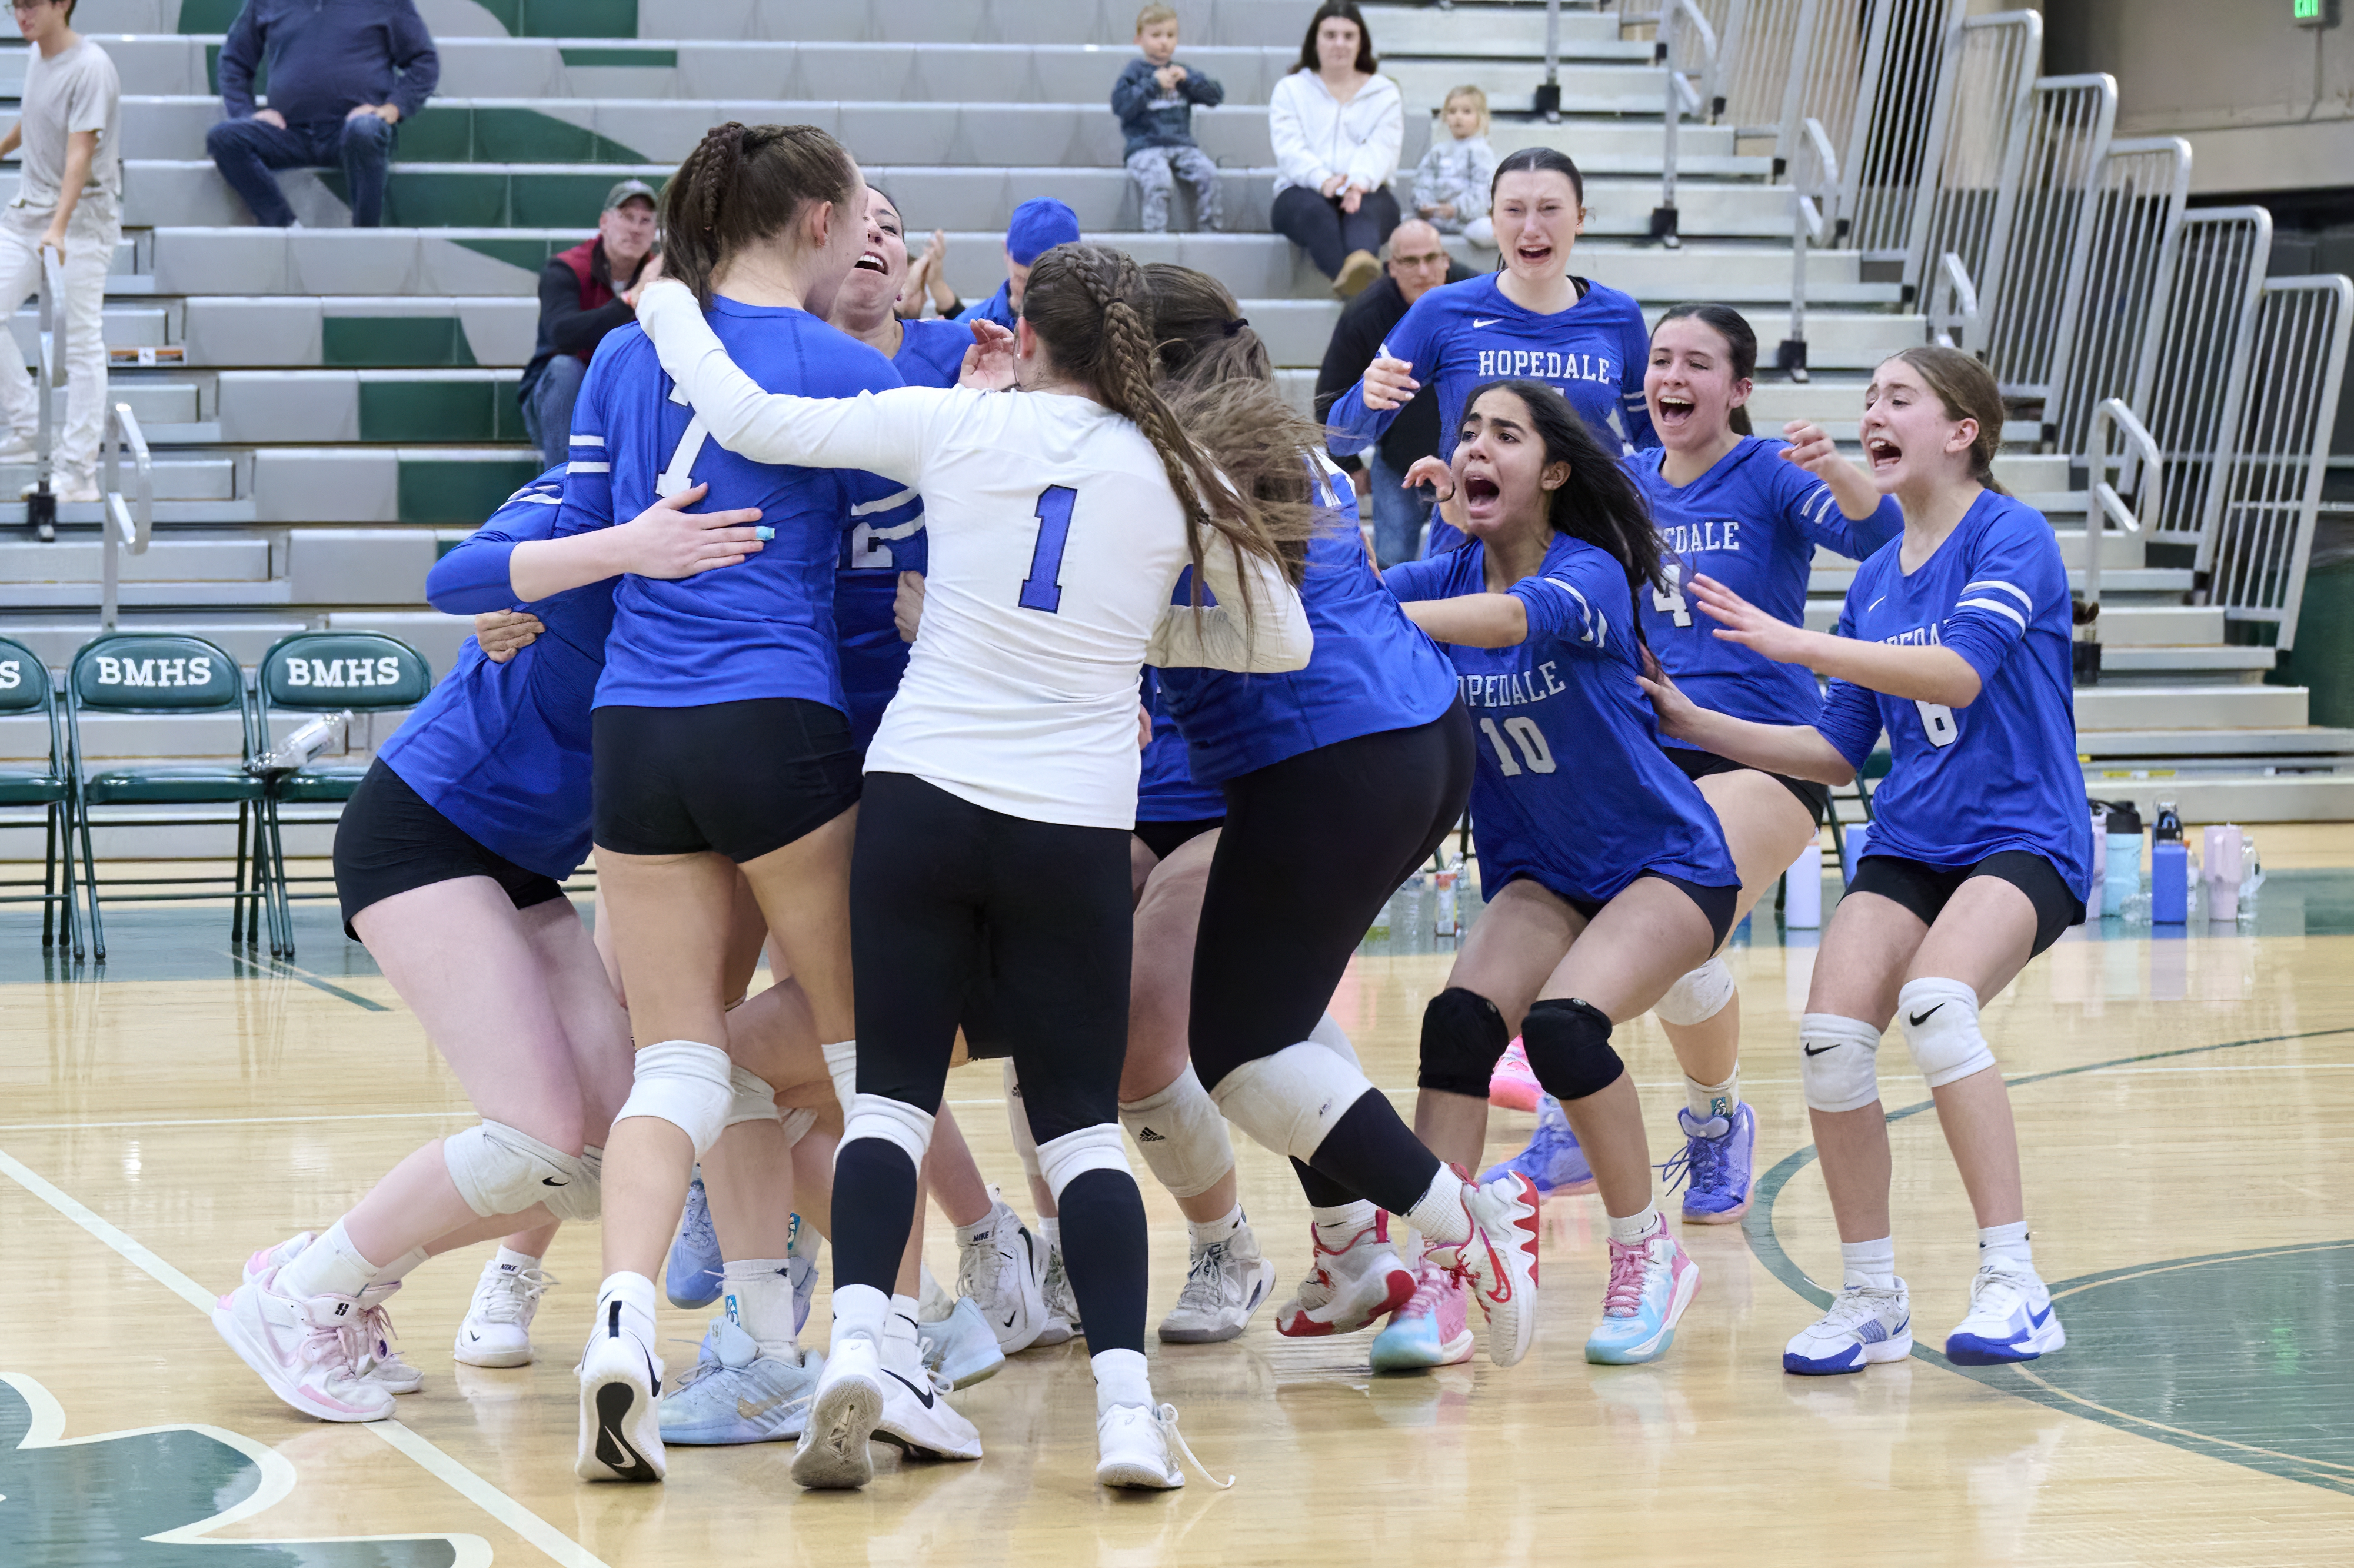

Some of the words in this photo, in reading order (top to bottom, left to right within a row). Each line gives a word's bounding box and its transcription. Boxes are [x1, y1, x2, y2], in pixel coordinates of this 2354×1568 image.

[1479, 349, 1610, 385] HOPEDALE
[1018, 484, 1078, 614] 1
[1652, 564, 1692, 628] 4
[96, 656, 212, 687] BMHS
[285, 656, 400, 688] BMHS
[1480, 716, 1557, 777] 10
[973, 1231, 990, 1242] NIKE
